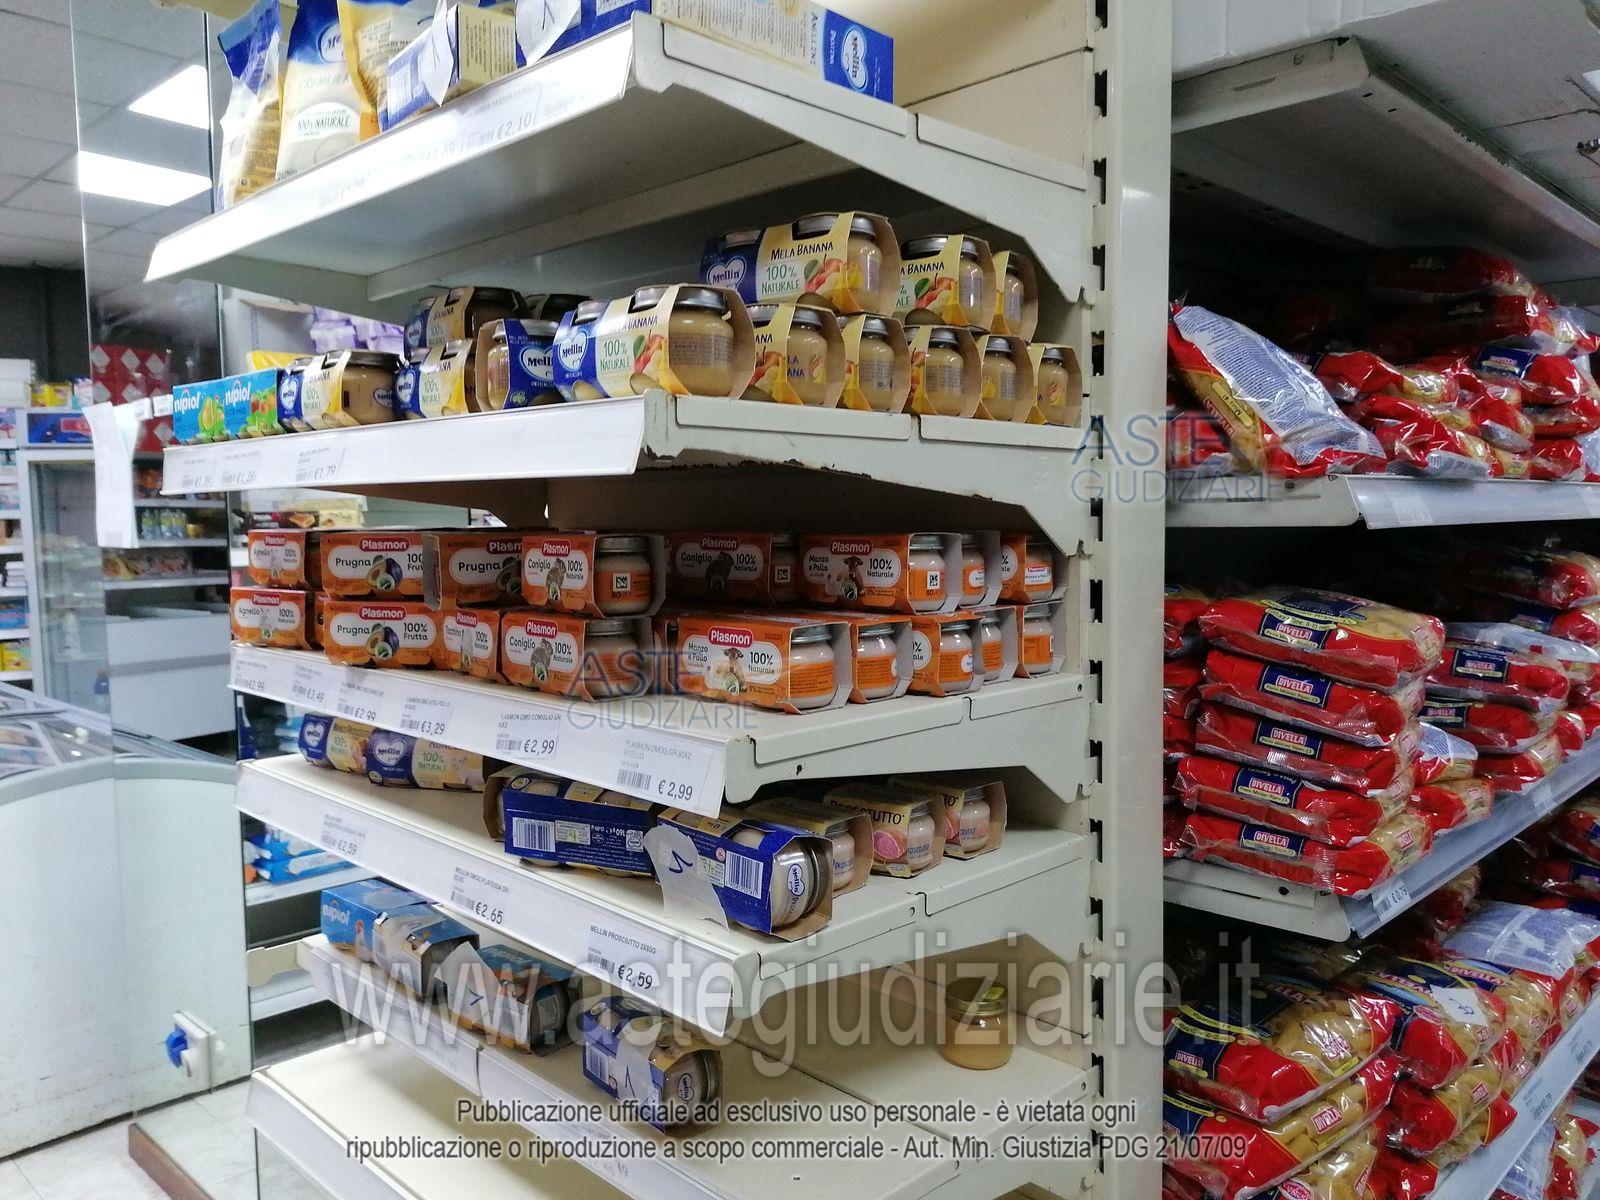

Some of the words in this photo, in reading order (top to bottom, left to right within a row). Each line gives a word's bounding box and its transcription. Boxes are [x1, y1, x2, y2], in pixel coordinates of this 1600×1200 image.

[316, 116, 350, 129] NATURALE
[771, 245, 796, 261] MELA
[797, 242, 834, 257] BANANA
[766, 264, 797, 280] 100%
[906, 261, 945, 275] BANANA
[712, 270, 740, 283] Mellin
[761, 281, 801, 295] NATURALE
[561, 345, 584, 357] Mellin
[603, 339, 628, 358] 100%
[600, 357, 630, 372] NATURALE
[225, 385, 251, 405] nipiol
[173, 394, 201, 414] nipiol
[361, 540, 408, 550] Plasmon
[489, 541, 523, 552] Plasm
[543, 542, 569, 554] Plasmon
[701, 538, 737, 549] Plasmon
[832, 541, 870, 553] Plasmon
[335, 557, 371, 569] Prugna
[407, 553, 424, 563] 100
[528, 558, 551, 570] Coniglio
[681, 552, 713, 564] Coniglio
[735, 553, 756, 565] 100%
[808, 554, 829, 564] Manzo
[868, 557, 892, 570] 100%
[458, 561, 501, 573] Prugna
[567, 559, 583, 572] 100%
[867, 570, 894, 578] Naturale
[253, 594, 280, 605] Plasmon
[278, 608, 295, 618] 100%
[361, 608, 404, 619] Plasmon
[337, 625, 370, 635] Prugna
[403, 622, 428, 633] 100%
[526, 621, 557, 637] Plasmon
[1277, 623, 1312, 640] DIVELLA
[403, 633, 428, 641] Frutta
[509, 636, 536, 650] Coniglio
[710, 629, 751, 644] Plasmon
[554, 642, 572, 656] 100%
[688, 643, 709, 653] Manzo
[553, 655, 573, 664] Naturale
[750, 651, 773, 666] 100%
[748, 665, 775, 675] Naturale
[1277, 677, 1311, 694] DIVELLA
[1272, 729, 1305, 745] DIVELLA
[423, 752, 445, 764] 100%
[1250, 779, 1283, 795] DIVELLA
[1256, 832, 1287, 847] DIVELLA
[791, 867, 800, 893] Mellin
[590, 925, 608, 937] MELLIN
[608, 931, 640, 948] PROSCIUTTO
[617, 964, 653, 990] €2,59
